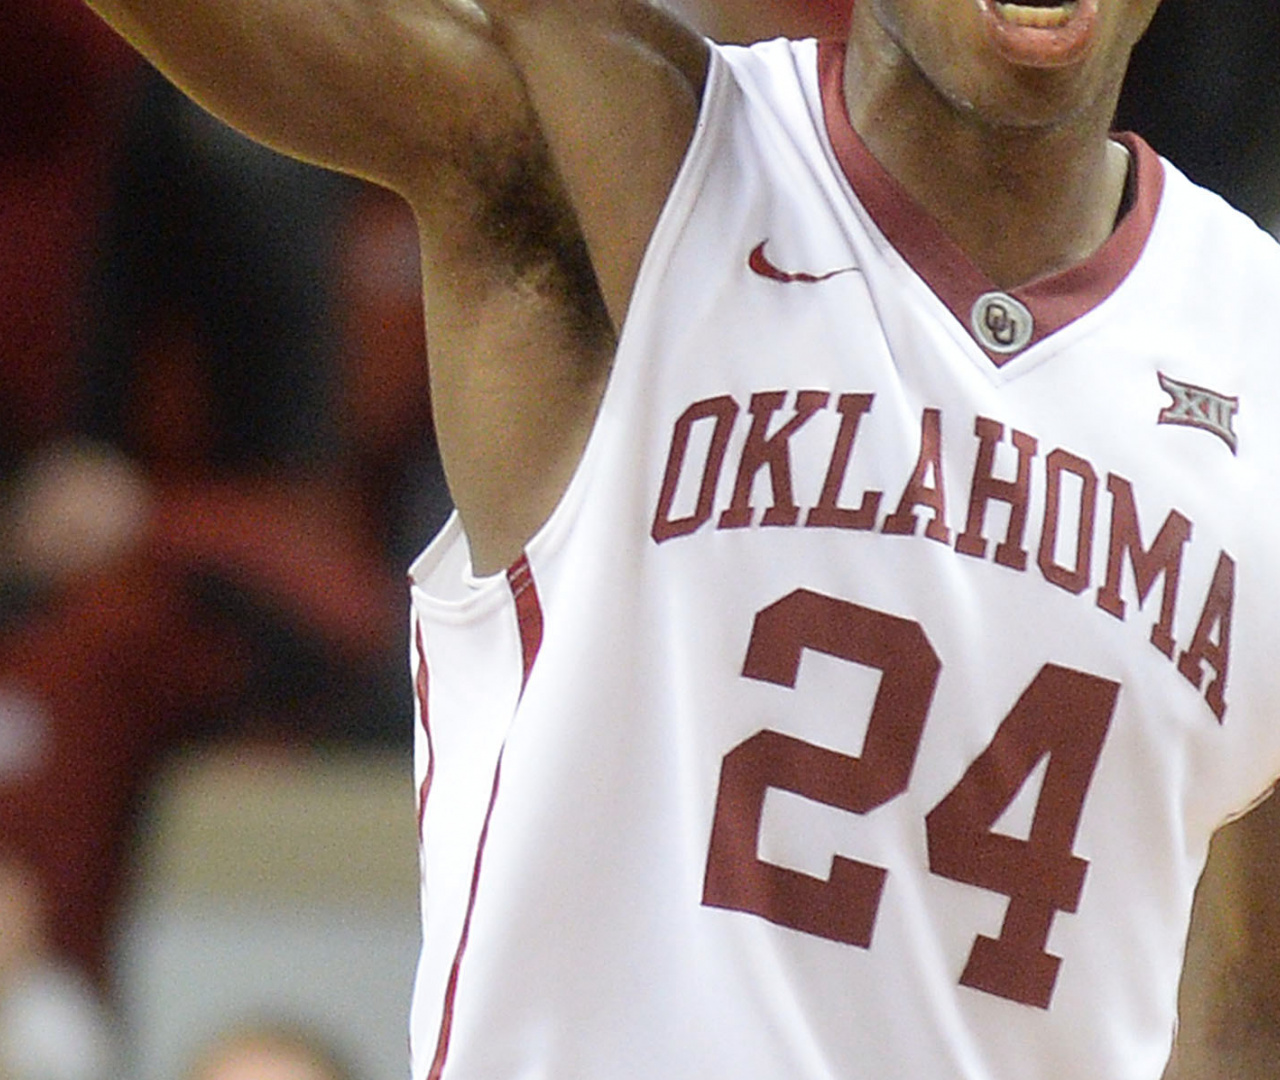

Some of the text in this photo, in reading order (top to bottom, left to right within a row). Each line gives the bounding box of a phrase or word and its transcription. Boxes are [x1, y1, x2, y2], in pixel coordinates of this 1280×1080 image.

[985, 304, 1015, 346] OU
[651, 390, 1236, 726] OKLAHOMA
[701, 587, 1122, 1011] 24
